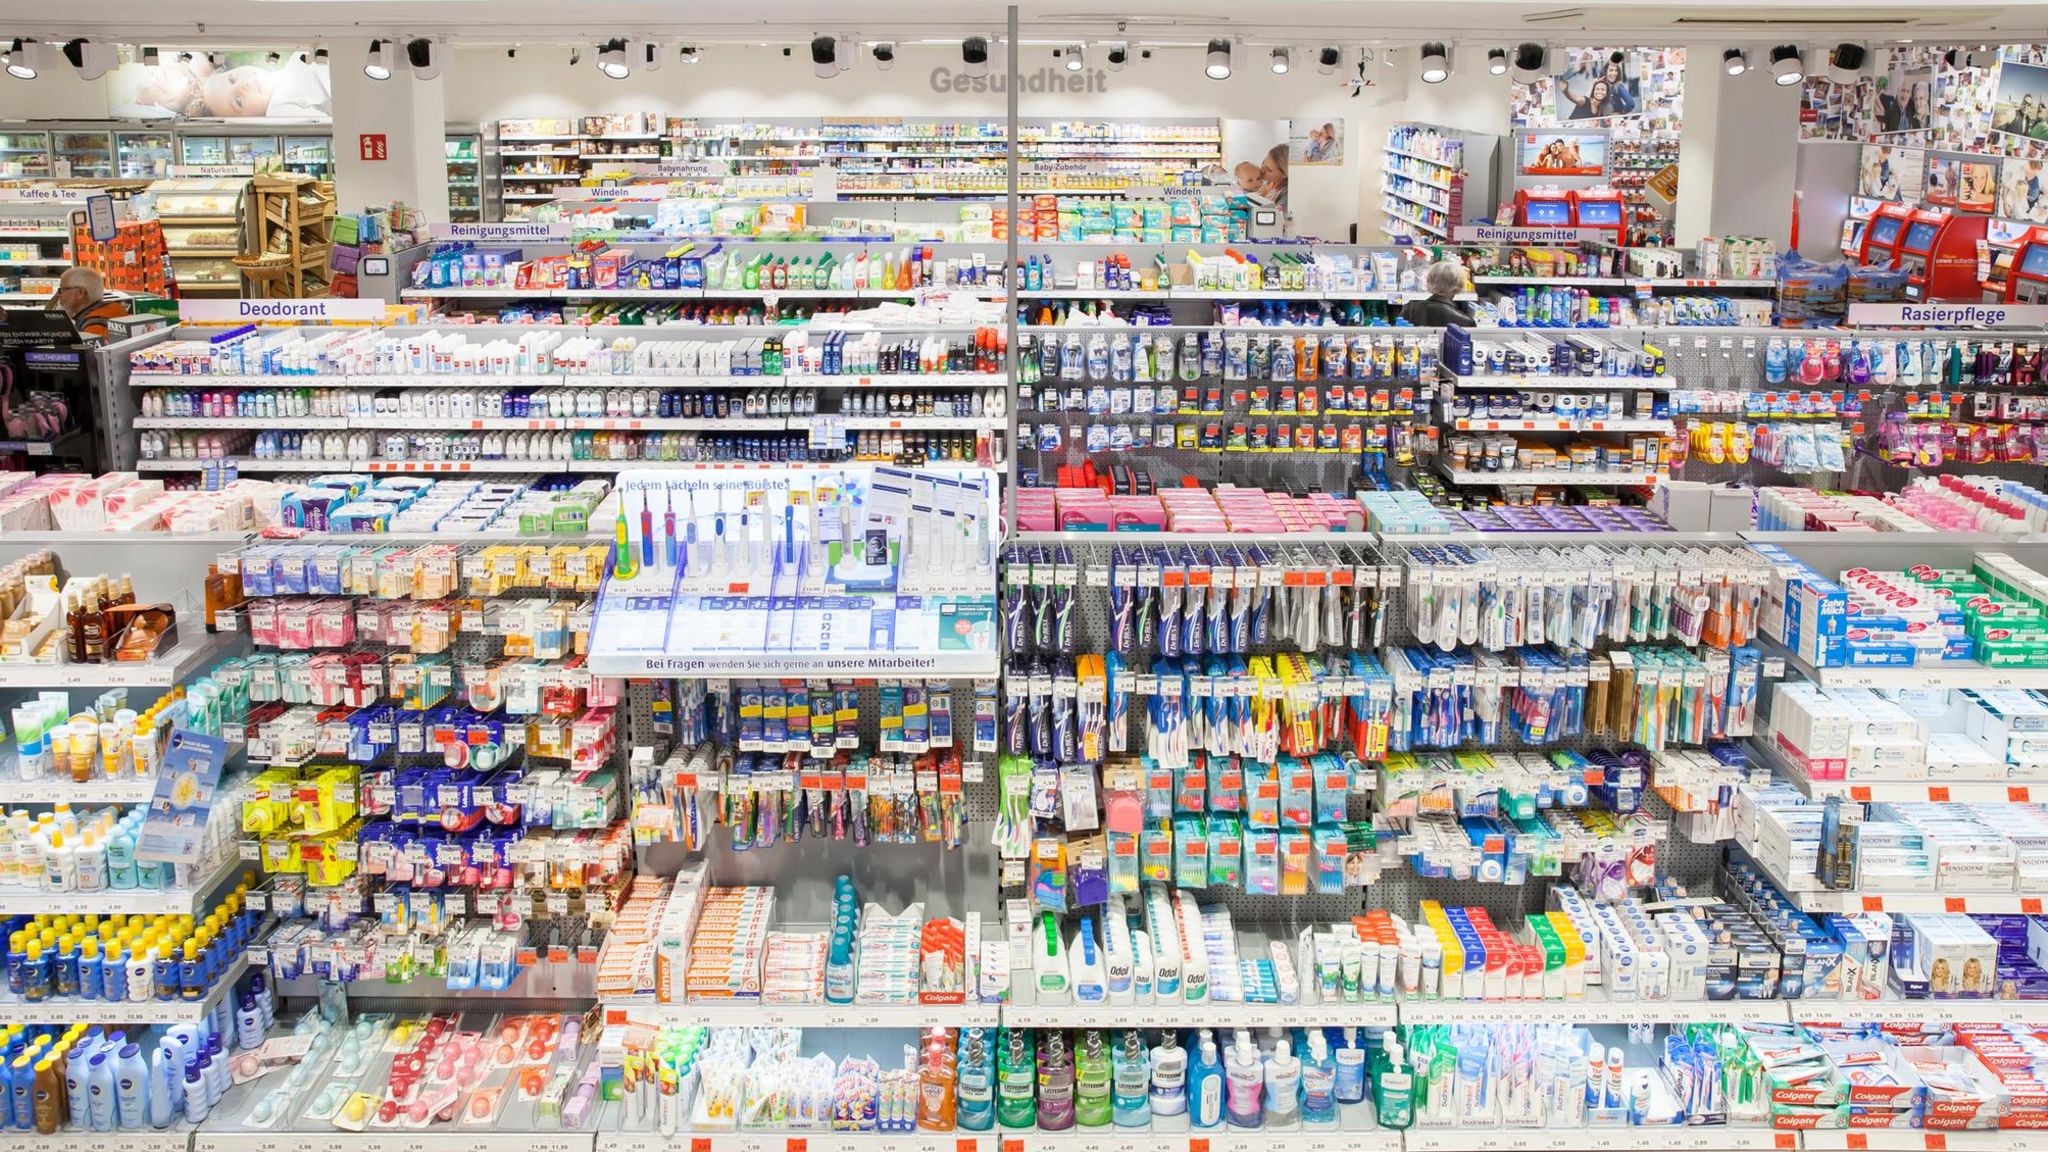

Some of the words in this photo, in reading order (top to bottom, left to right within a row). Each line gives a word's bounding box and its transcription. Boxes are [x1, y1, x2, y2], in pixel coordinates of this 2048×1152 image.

[930, 67, 1107, 93] Gesundheit
[200, 166, 238, 174] Naturkost
[658, 164, 708, 174] Babynahrung
[1034, 163, 1087, 172] Baby-Zubehör
[20, 190, 51, 199] Kaffee
[52, 190, 58, 199] &
[60, 190, 77, 199] Tee
[591, 188, 629, 197] Windeln
[1163, 188, 1202, 196] Windeln
[450, 224, 550, 238] Reinigungsmittel
[1477, 227, 1577, 241] Reinigungsmittel
[240, 301, 326, 315] Deodorant
[1902, 306, 2006, 324] Rasierpflege
[108, 321, 127, 334] PARSA
[626, 480, 662, 493] Jedem
[666, 480, 709, 490] Lächeln
[713, 481, 743, 490] seine
[1821, 599, 1845, 609] Zahn
[1821, 607, 1845, 616] Milch
[646, 659, 664, 669] Bei
[668, 660, 705, 671] Fragen
[708, 660, 744, 668] wenden
[747, 660, 760, 668] Sie
[763, 660, 781, 668] sich
[783, 661, 809, 671] gerne
[827, 660, 865, 668] unsere
[868, 658, 935, 668] Mitarbeiter!
[1806, 956, 1837, 967] BLANX
[1110, 967, 1129, 977] Odol
[1159, 968, 1177, 978] Odol
[662, 960, 671, 999] elmex
[688, 978, 724, 986] elmex
[1187, 974, 1205, 984] Odol
[925, 994, 958, 1002] Colgate
[1884, 1022, 1920, 1030] Colgate
[1776, 1092, 1814, 1101] Colgate
[1855, 1093, 1891, 1102] Colgate
[1937, 1104, 1976, 1113] Colgate
[1777, 1116, 1816, 1126] Colgate
[1851, 1116, 1890, 1126] Colgate
[1928, 1118, 1967, 1126] Colgate
